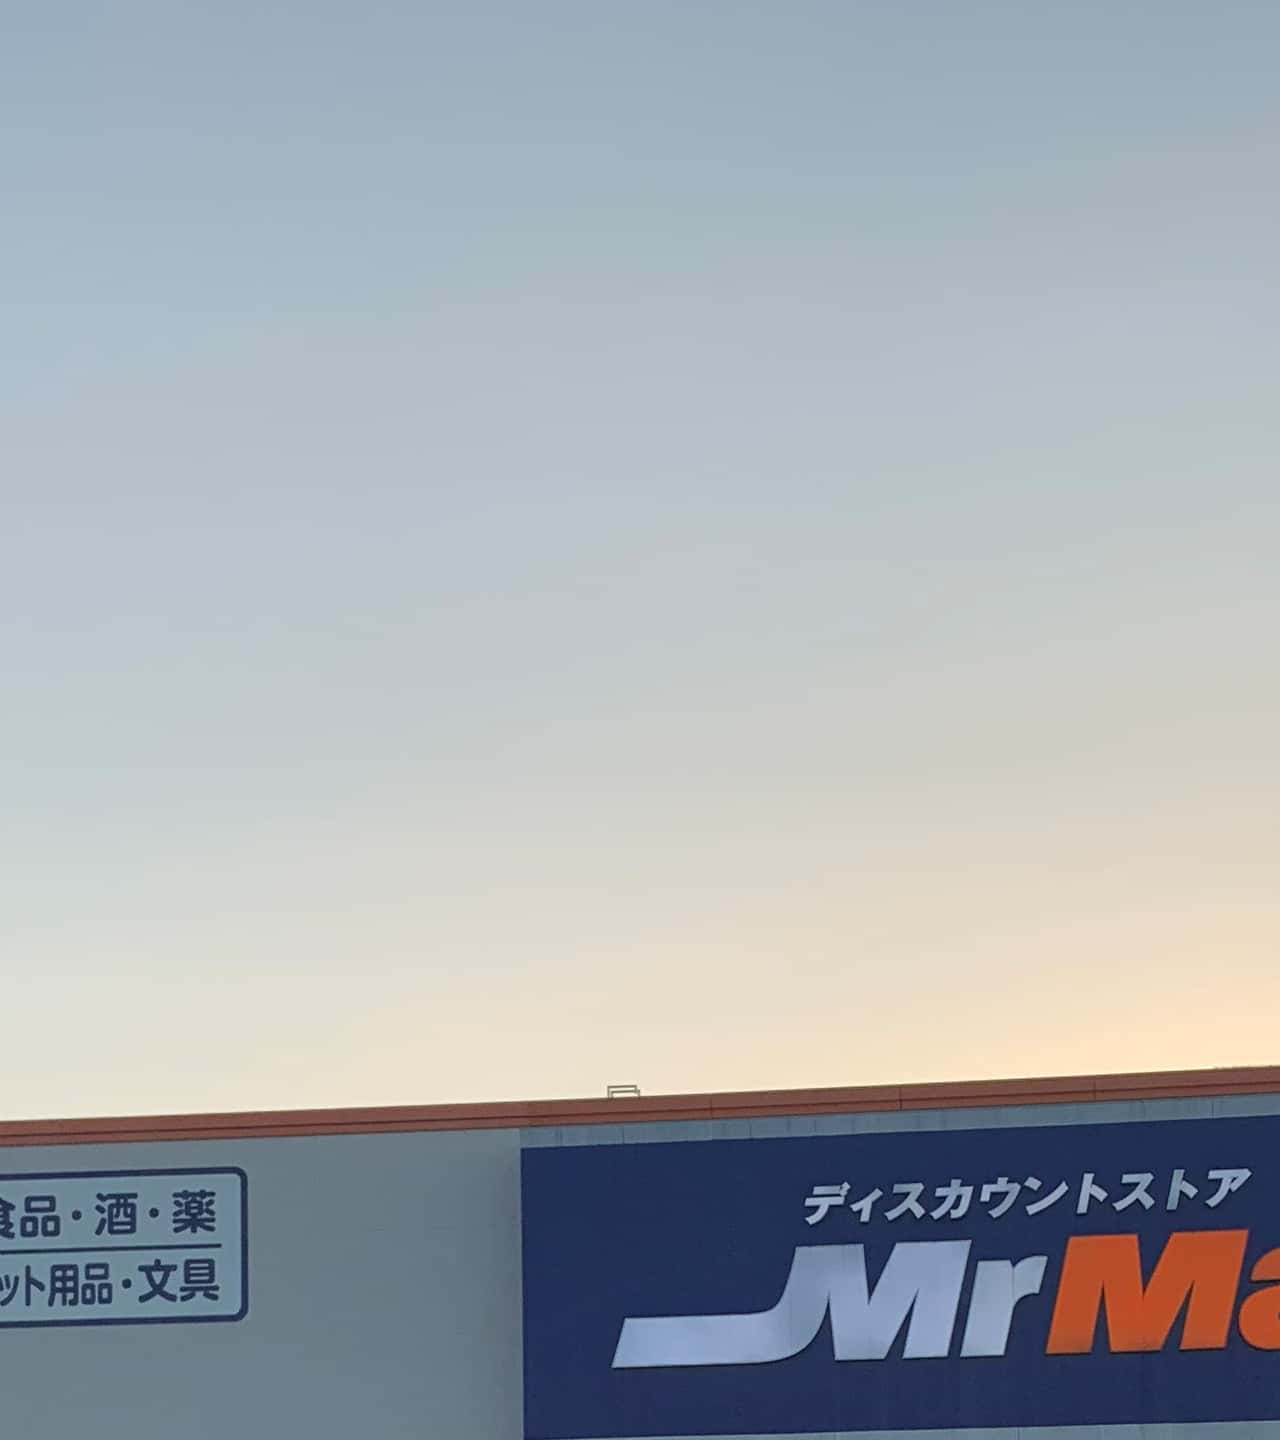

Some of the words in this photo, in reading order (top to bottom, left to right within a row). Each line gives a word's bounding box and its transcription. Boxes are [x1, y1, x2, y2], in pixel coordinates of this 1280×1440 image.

[804, 1168, 1252, 1225] ディスカウントストア
